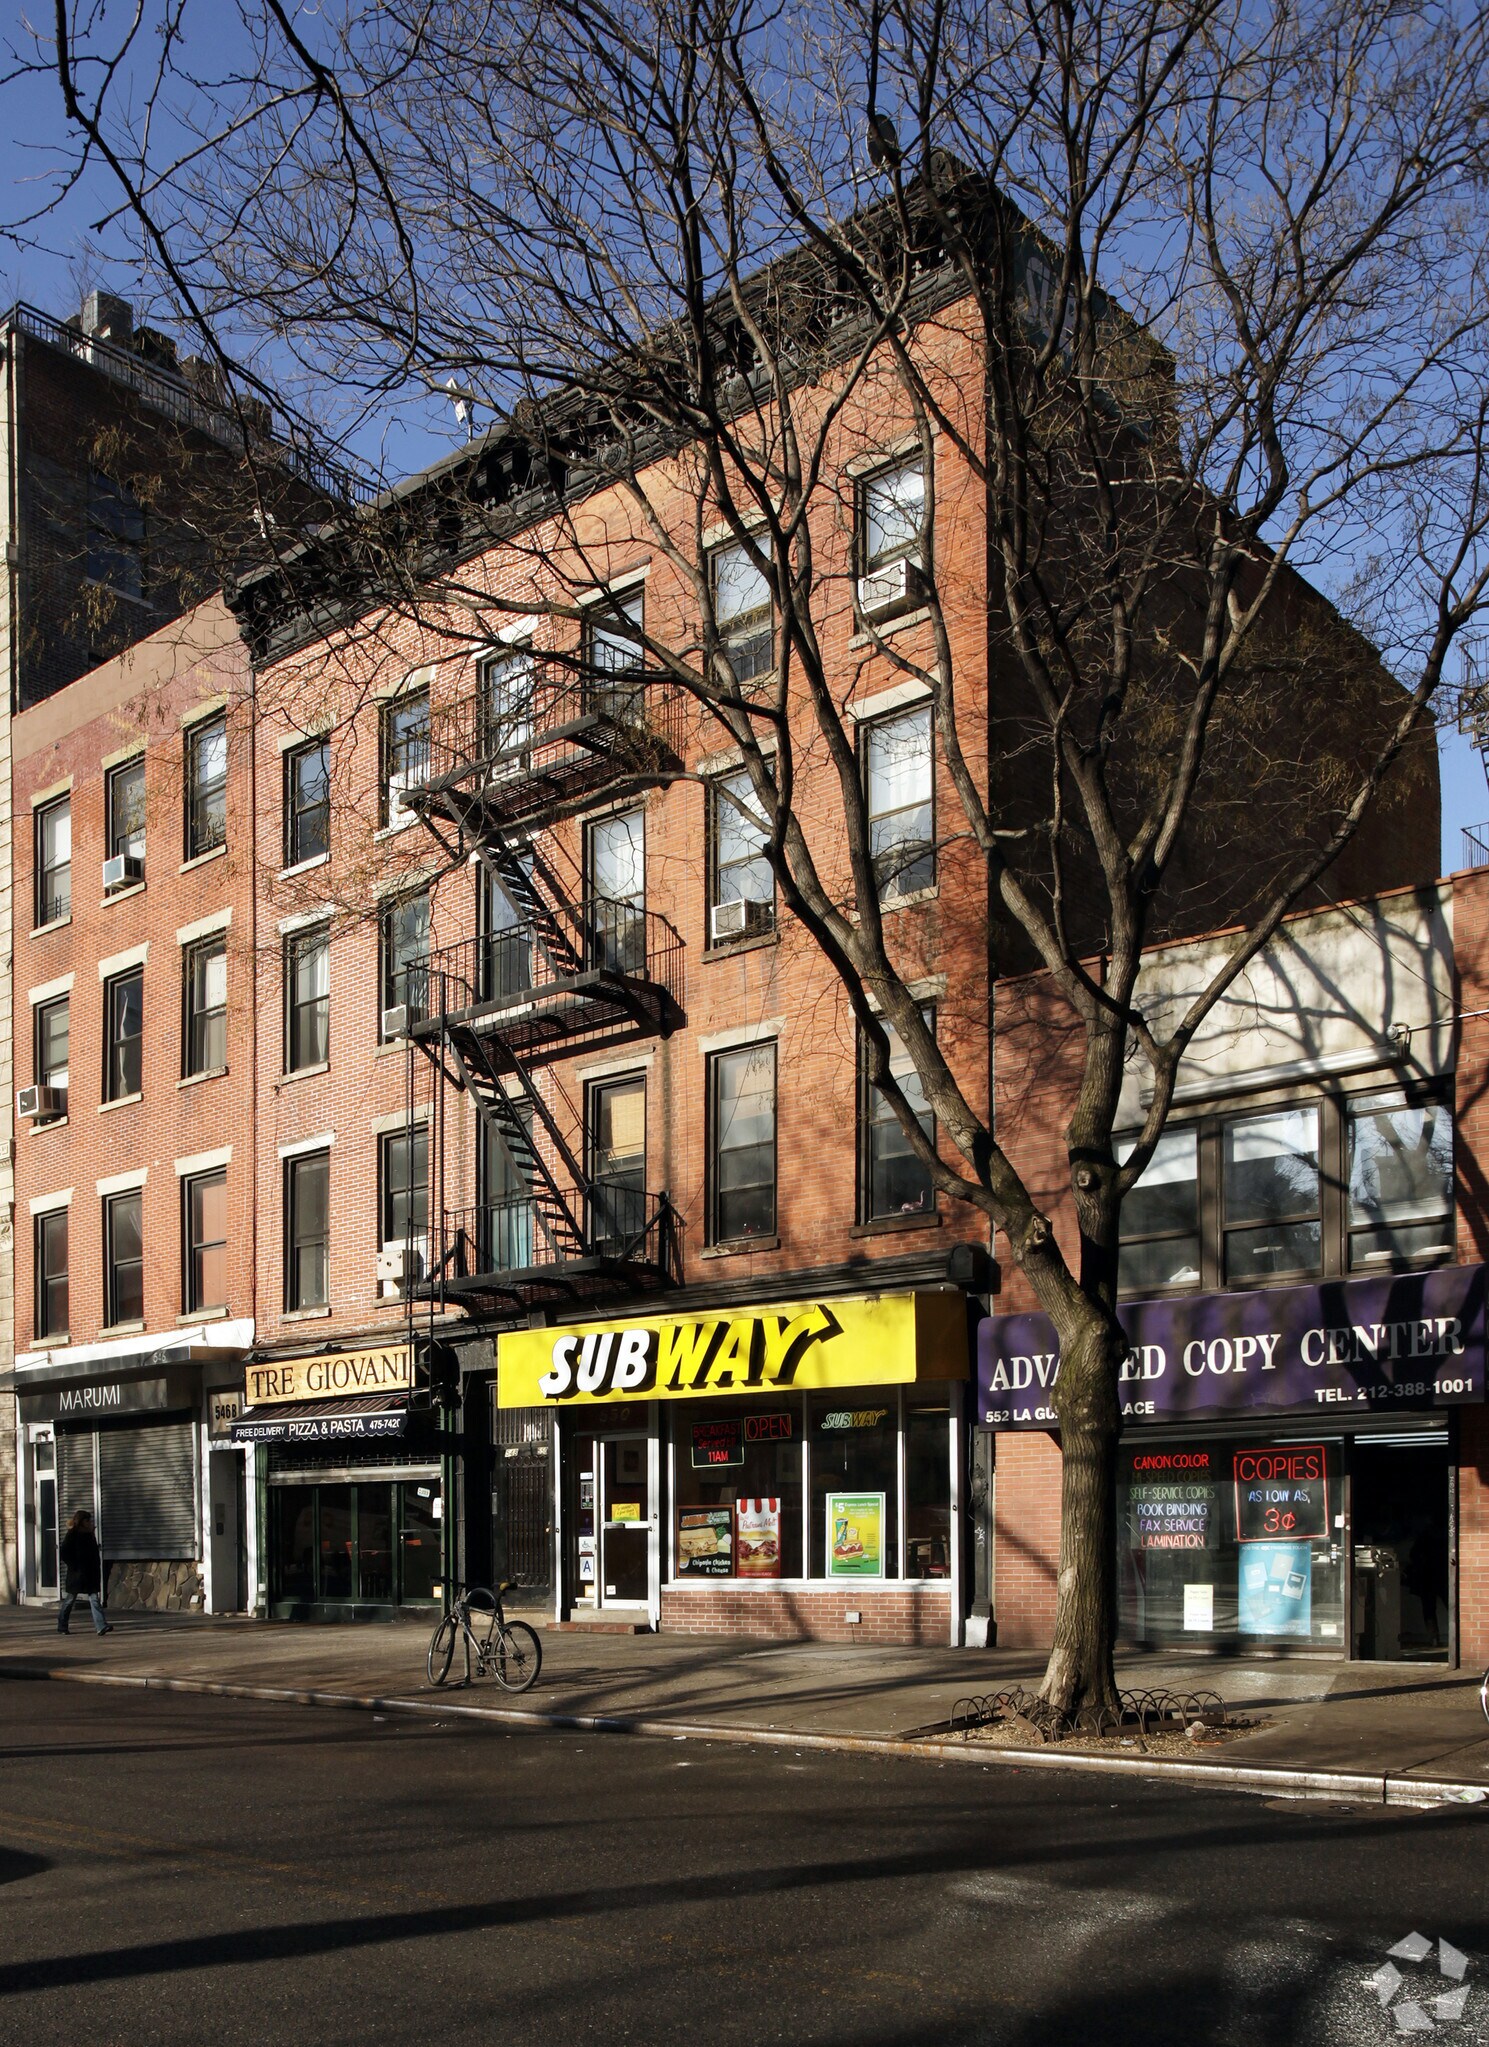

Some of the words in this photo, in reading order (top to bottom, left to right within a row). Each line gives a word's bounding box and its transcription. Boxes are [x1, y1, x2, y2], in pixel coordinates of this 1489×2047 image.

[539, 1304, 843, 1398] SUBWAY
[989, 1345, 1166, 1391] ADVED
[1183, 1334, 1281, 1376] COPY
[1300, 1317, 1465, 1367] CENTER
[251, 1367, 295, 1398] TRE
[306, 1352, 409, 1391] GIOVANI
[59, 1384, 121, 1411] MARUMI
[1315, 1388, 1352, 1403] TEL.
[1357, 1378, 1474, 1401] 212-388-1001
[215, 1403, 238, 1420] 546B
[986, 1410, 1010, 1423] 552
[1013, 1408, 1032, 1421] LA
[1122, 1401, 1155, 1415] ACE
[747, 1415, 791, 1439] OPEN
[821, 1409, 888, 1429] SUBWAY
[236, 1428, 253, 1437] FREE
[253, 1425, 286, 1436] DELIVERY
[288, 1422, 319, 1436] PIZZA
[320, 1422, 328, 1434] &
[330, 1419, 365, 1433] PASTA
[693, 1423, 741, 1438] BREAKFAST
[708, 1450, 729, 1463] 11AM
[1133, 1455, 1171, 1470] CANON
[1172, 1453, 1209, 1467] COLOR
[1132, 1470, 1174, 1483] HI-SPEED
[1176, 1469, 1212, 1482] COPIES
[1239, 1455, 1319, 1481] COPIES
[1130, 1486, 1184, 1500] SELF-SERVICE
[1185, 1485, 1216, 1499] COPIES
[1248, 1489, 1263, 1502] AS
[1137, 1503, 1164, 1516] BOOK
[1166, 1502, 1208, 1516] BINDING
[1139, 1519, 1161, 1532] FAX
[1164, 1518, 1205, 1531] SERVICE
[1263, 1507, 1296, 1533] 3¢
[1141, 1534, 1204, 1548] LAMINATION
[582, 1560, 592, 1573] A
